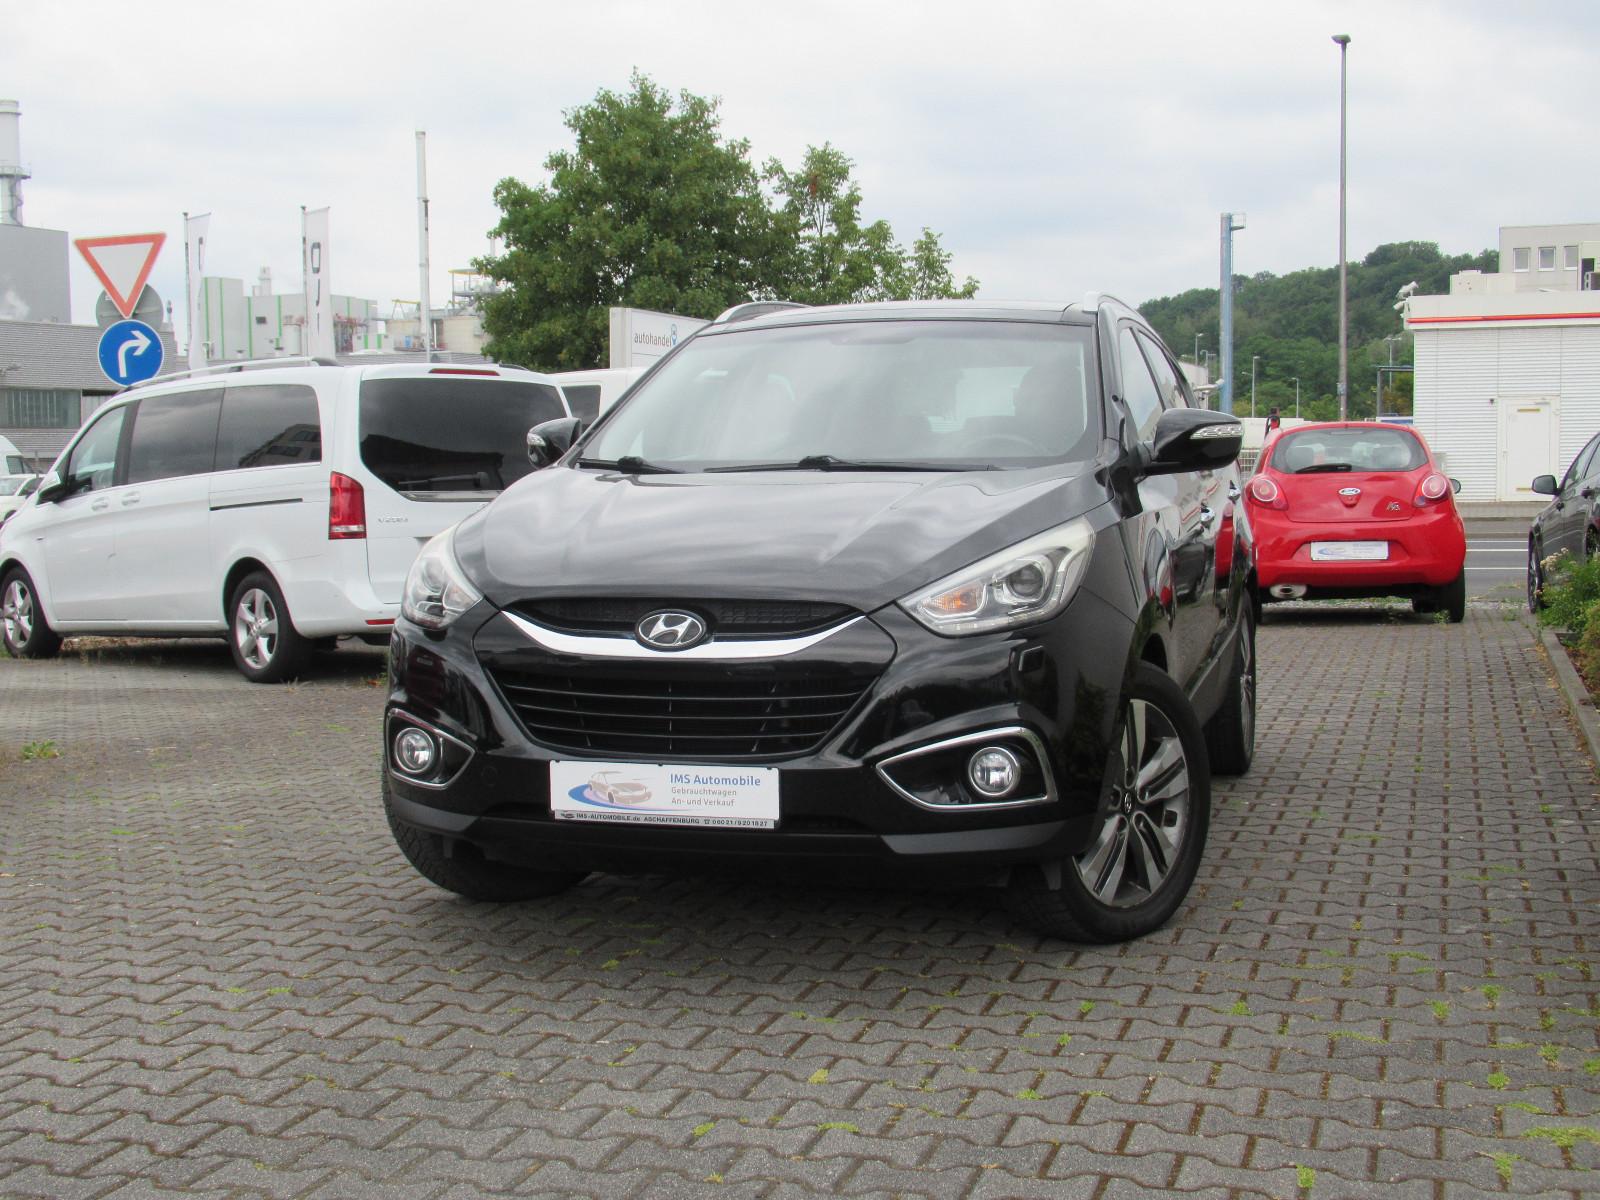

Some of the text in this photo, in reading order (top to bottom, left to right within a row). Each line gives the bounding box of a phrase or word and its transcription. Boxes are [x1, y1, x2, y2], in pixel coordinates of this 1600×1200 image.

[634, 332, 672, 348] autohandel
[670, 773, 761, 786] IMS Automobile
[671, 786, 737, 797] Gebrauchtwagen
[671, 797, 736, 807] An- und Verkauf
[643, 816, 700, 825] ASCHAFFENBURG
